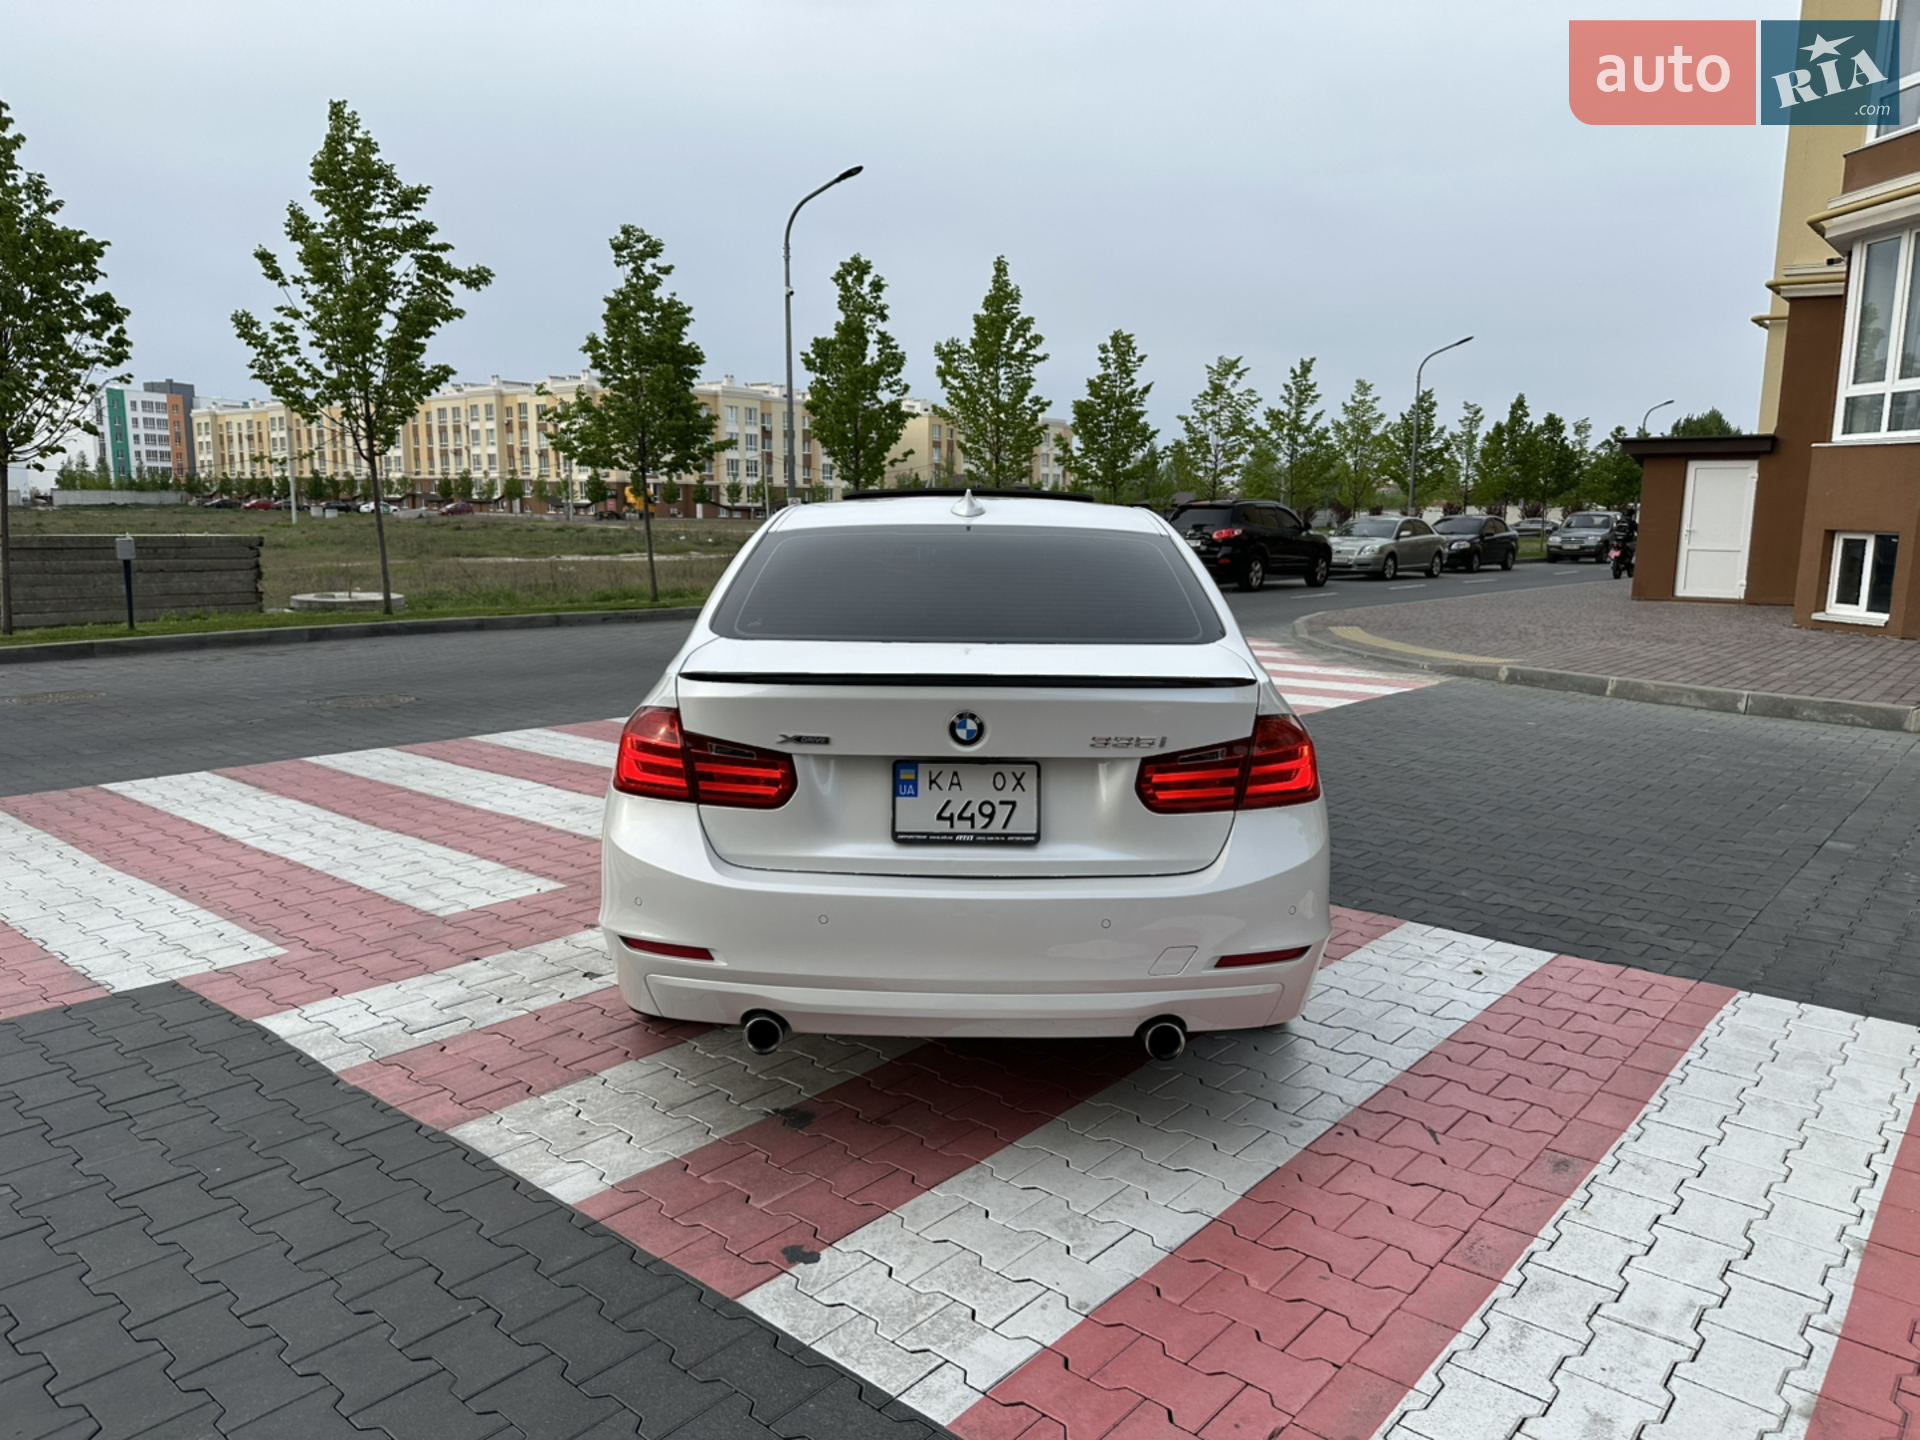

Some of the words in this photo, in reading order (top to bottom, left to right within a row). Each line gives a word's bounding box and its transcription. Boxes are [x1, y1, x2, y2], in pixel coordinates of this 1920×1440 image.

[898, 784, 916, 796] UA
[928, 770, 963, 792] KA
[935, 799, 1018, 830] 4497
